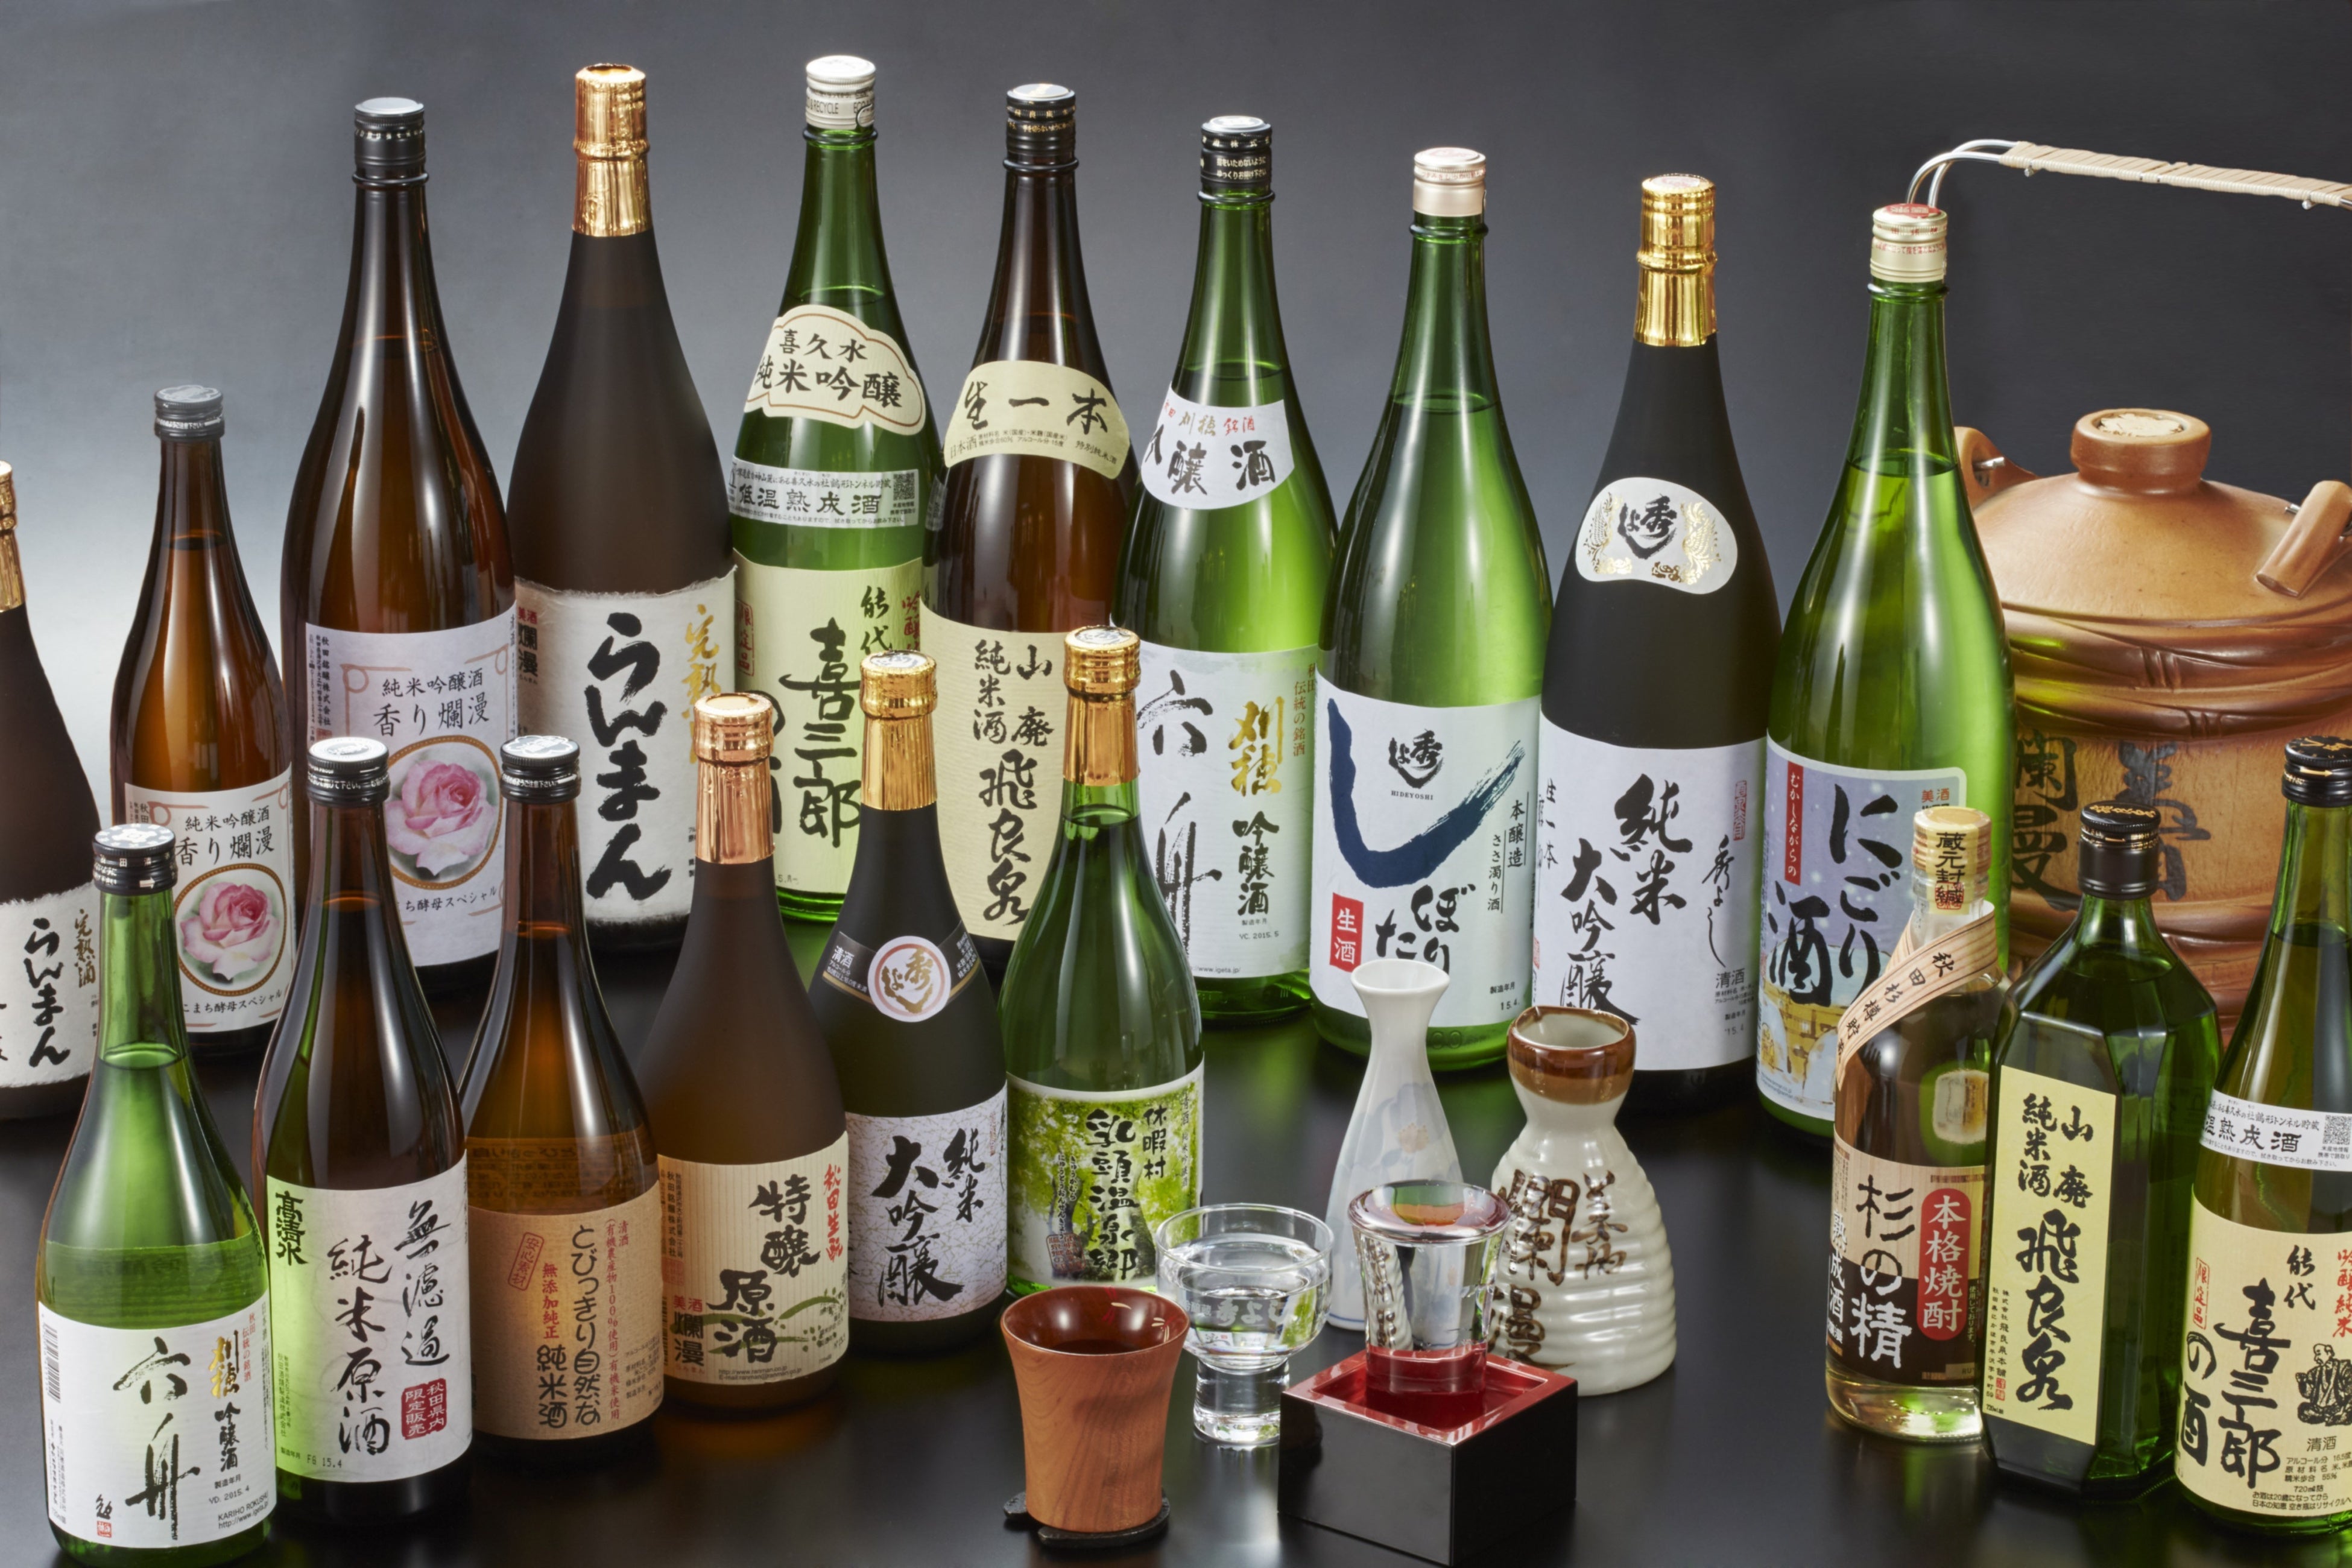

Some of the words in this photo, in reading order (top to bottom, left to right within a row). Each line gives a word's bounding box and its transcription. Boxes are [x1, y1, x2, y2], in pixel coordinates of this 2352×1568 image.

[814, 100, 839, 114] RECYCLE
[779, 328, 868, 362] 喜久水
[754, 354, 902, 408] 純米吟醸
[964, 381, 1108, 435] 生一本
[950, 434, 978, 459] 日本酒
[739, 484, 882, 516] 低温熟成酒
[518, 606, 537, 624] 美酒
[381, 667, 483, 698] 純米吟醸酒
[517, 622, 538, 677] 爛漫
[373, 691, 490, 737] 香り爛漫
[973, 639, 1011, 744] 純米酒
[1011, 645, 1055, 747] 山廃
[1292, 680, 1306, 757] 伝統の銘酒
[584, 612, 673, 900] らんまん
[779, 616, 862, 849] 喜三郎
[1228, 695, 1285, 797] 刈穂
[185, 805, 270, 832] 純米吟醸酒
[1391, 790, 1434, 801] HIDEYOSHI
[1786, 771, 1801, 877] むかしながらの
[1921, 788, 1950, 804] 美酒
[175, 825, 274, 866] 香り爛漫
[1232, 810, 1280, 916] 吟醸酒
[1507, 799, 1526, 868] 本醸造
[1610, 773, 1693, 925] 純米
[397, 885, 498, 912] ち酵母スペシャル
[1487, 834, 1503, 912] ささ濁り酒
[1829, 783, 1903, 999] にごり
[832, 945, 855, 969] 清酒
[1333, 907, 1358, 965] 生酒
[1768, 880, 1833, 1007] 酒
[24, 917, 71, 1067] らんまん
[1715, 967, 1745, 989] 清酒
[941, 1127, 986, 1224] 純米
[1142, 1105, 1168, 1180] 休暇村
[2018, 1093, 2058, 1198] 純米酒
[2053, 1105, 2094, 1208] 山廃
[276, 1190, 309, 1266] 高清水
[618, 1220, 629, 1247] 清酒
[748, 1174, 821, 1278] 特醸
[870, 1135, 966, 1307] 大吟醸
[394, 1199, 451, 1367] 無濾過
[511, 1236, 540, 1286] 安心素材
[1830, 1209, 1847, 1323] 熟成酒
[1850, 1174, 1915, 1369] 杉の精
[1923, 1195, 1967, 1333] 本格焼酎
[2284, 1245, 2316, 1310] 能代
[248, 1312, 256, 1335] 秋田
[542, 1262, 560, 1340] 無添加純正
[571, 1224, 601, 1426] とびっきり自然な
[674, 1295, 703, 1312] 美酒
[706, 1269, 777, 1364] 原酒
[208, 1329, 241, 1398] 刈穂
[242, 1327, 251, 1383] 伝統の銘酒
[327, 1234, 393, 1456] 純米原酒
[674, 1311, 704, 1367] 爛漫
[405, 1388, 426, 1437] 限定販売
[426, 1382, 445, 1430] 秋田県内
[537, 1344, 567, 1429] 純米酒
[2213, 1277, 2291, 1489] 喜三郎
[215, 1402, 241, 1472] 吟醸酒
[2284, 1465, 2328, 1473] 原材料名
[2286, 1456, 2328, 1465] アルコール分
[2307, 1435, 2337, 1452] 清酒
[214, 1473, 241, 1489] 製造年月
[218, 1506, 245, 1521] KARIHO
[2252, 1491, 2328, 1502] お酒は20歳になってから
